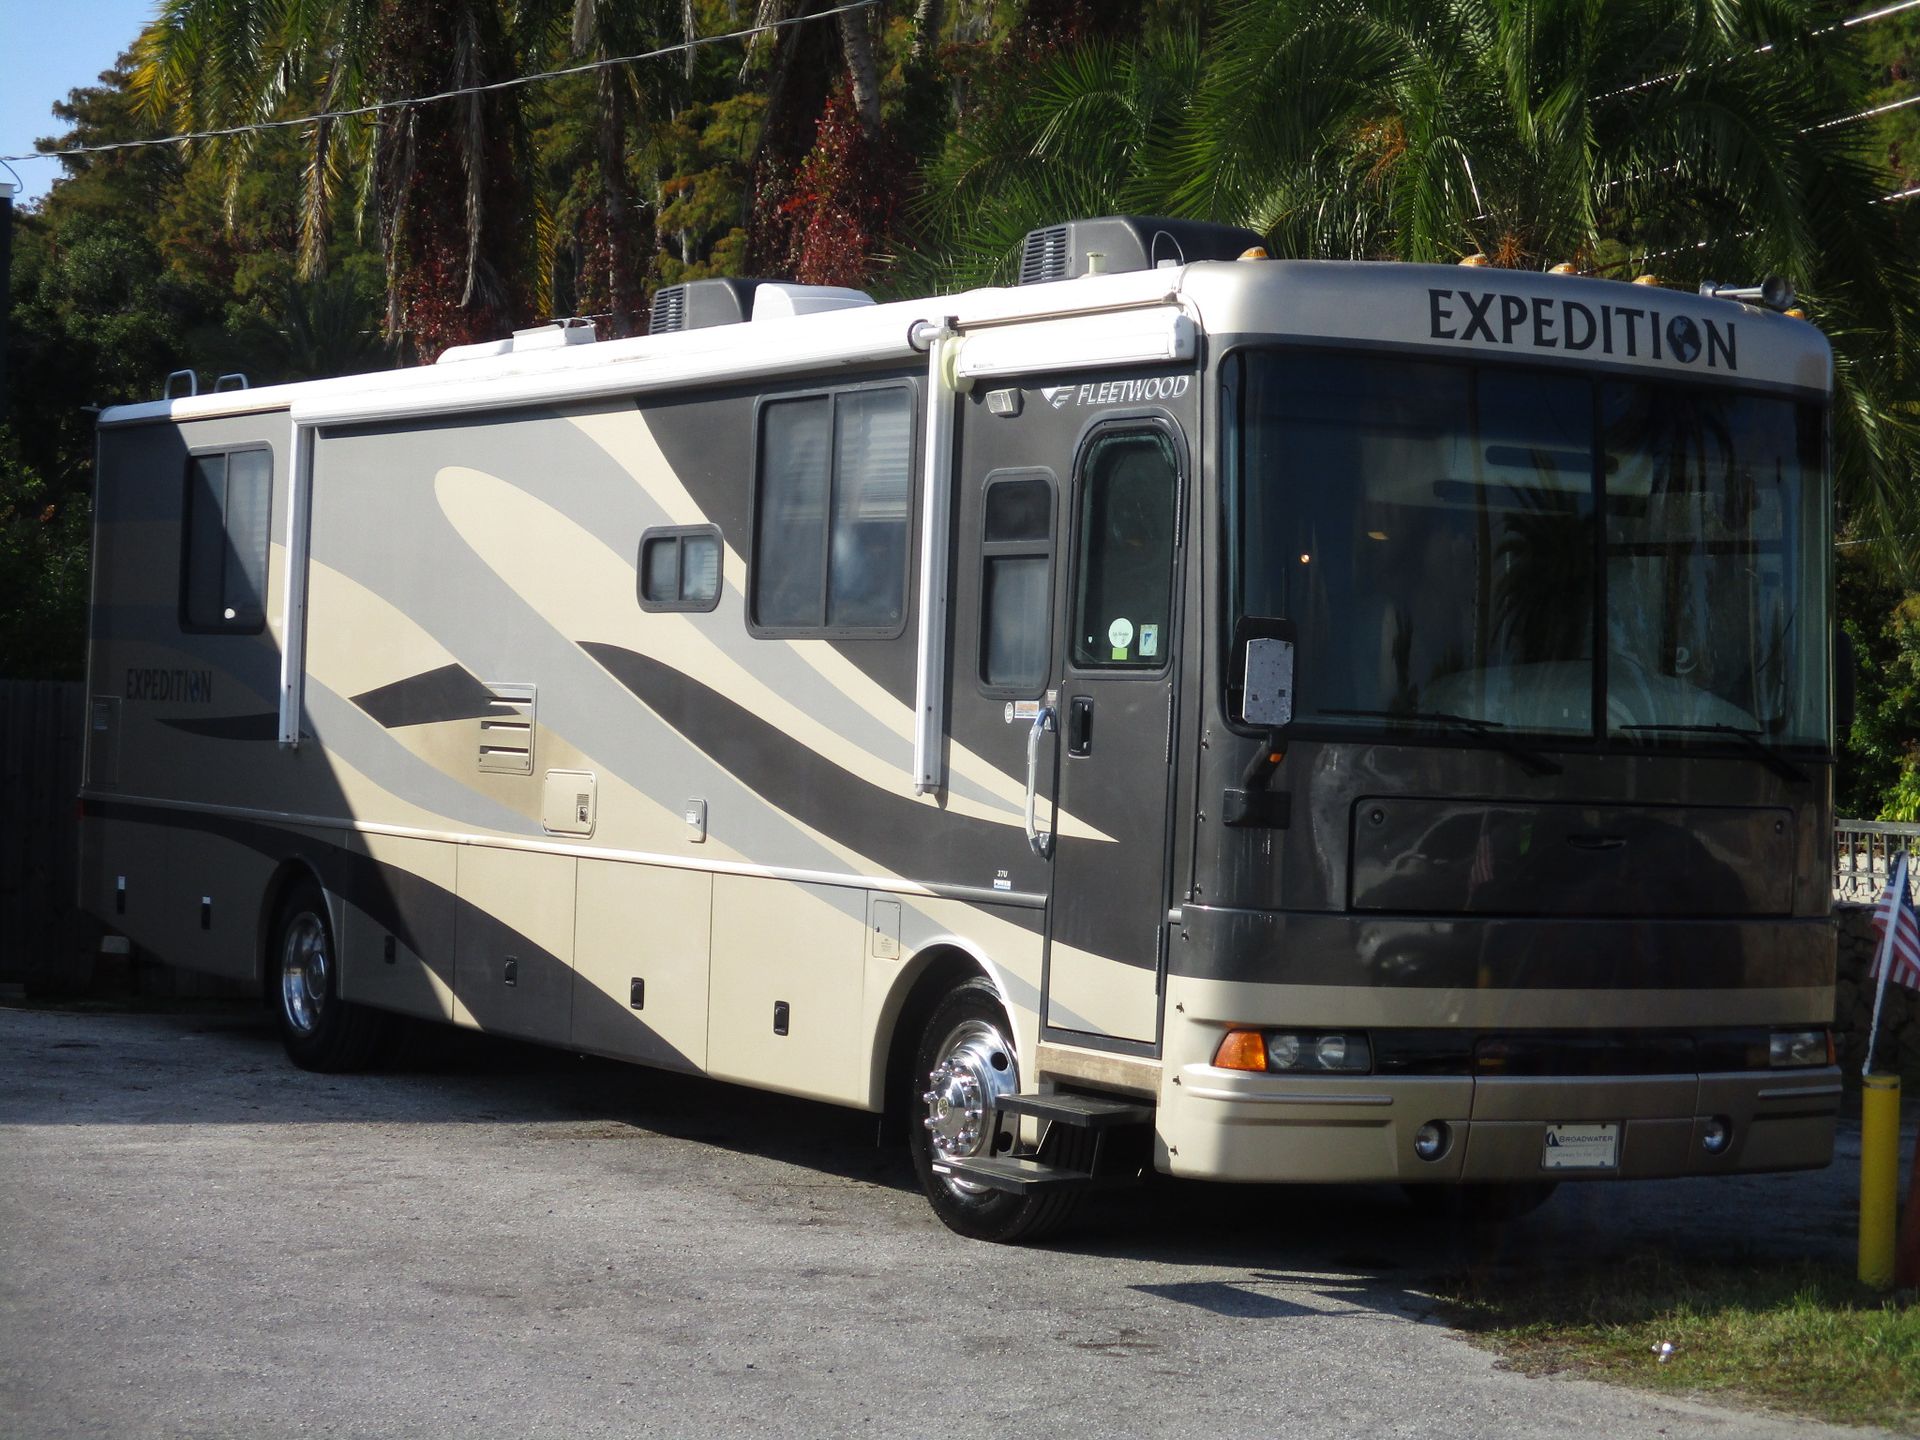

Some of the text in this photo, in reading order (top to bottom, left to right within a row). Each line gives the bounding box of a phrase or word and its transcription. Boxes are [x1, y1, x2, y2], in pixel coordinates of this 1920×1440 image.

[1428, 288, 1737, 370] EXPEDITION
[1077, 375, 1190, 406] FLEETWOOD
[127, 668, 212, 702] EXPEDITION
[1559, 1135, 1615, 1143] BROADWATER
